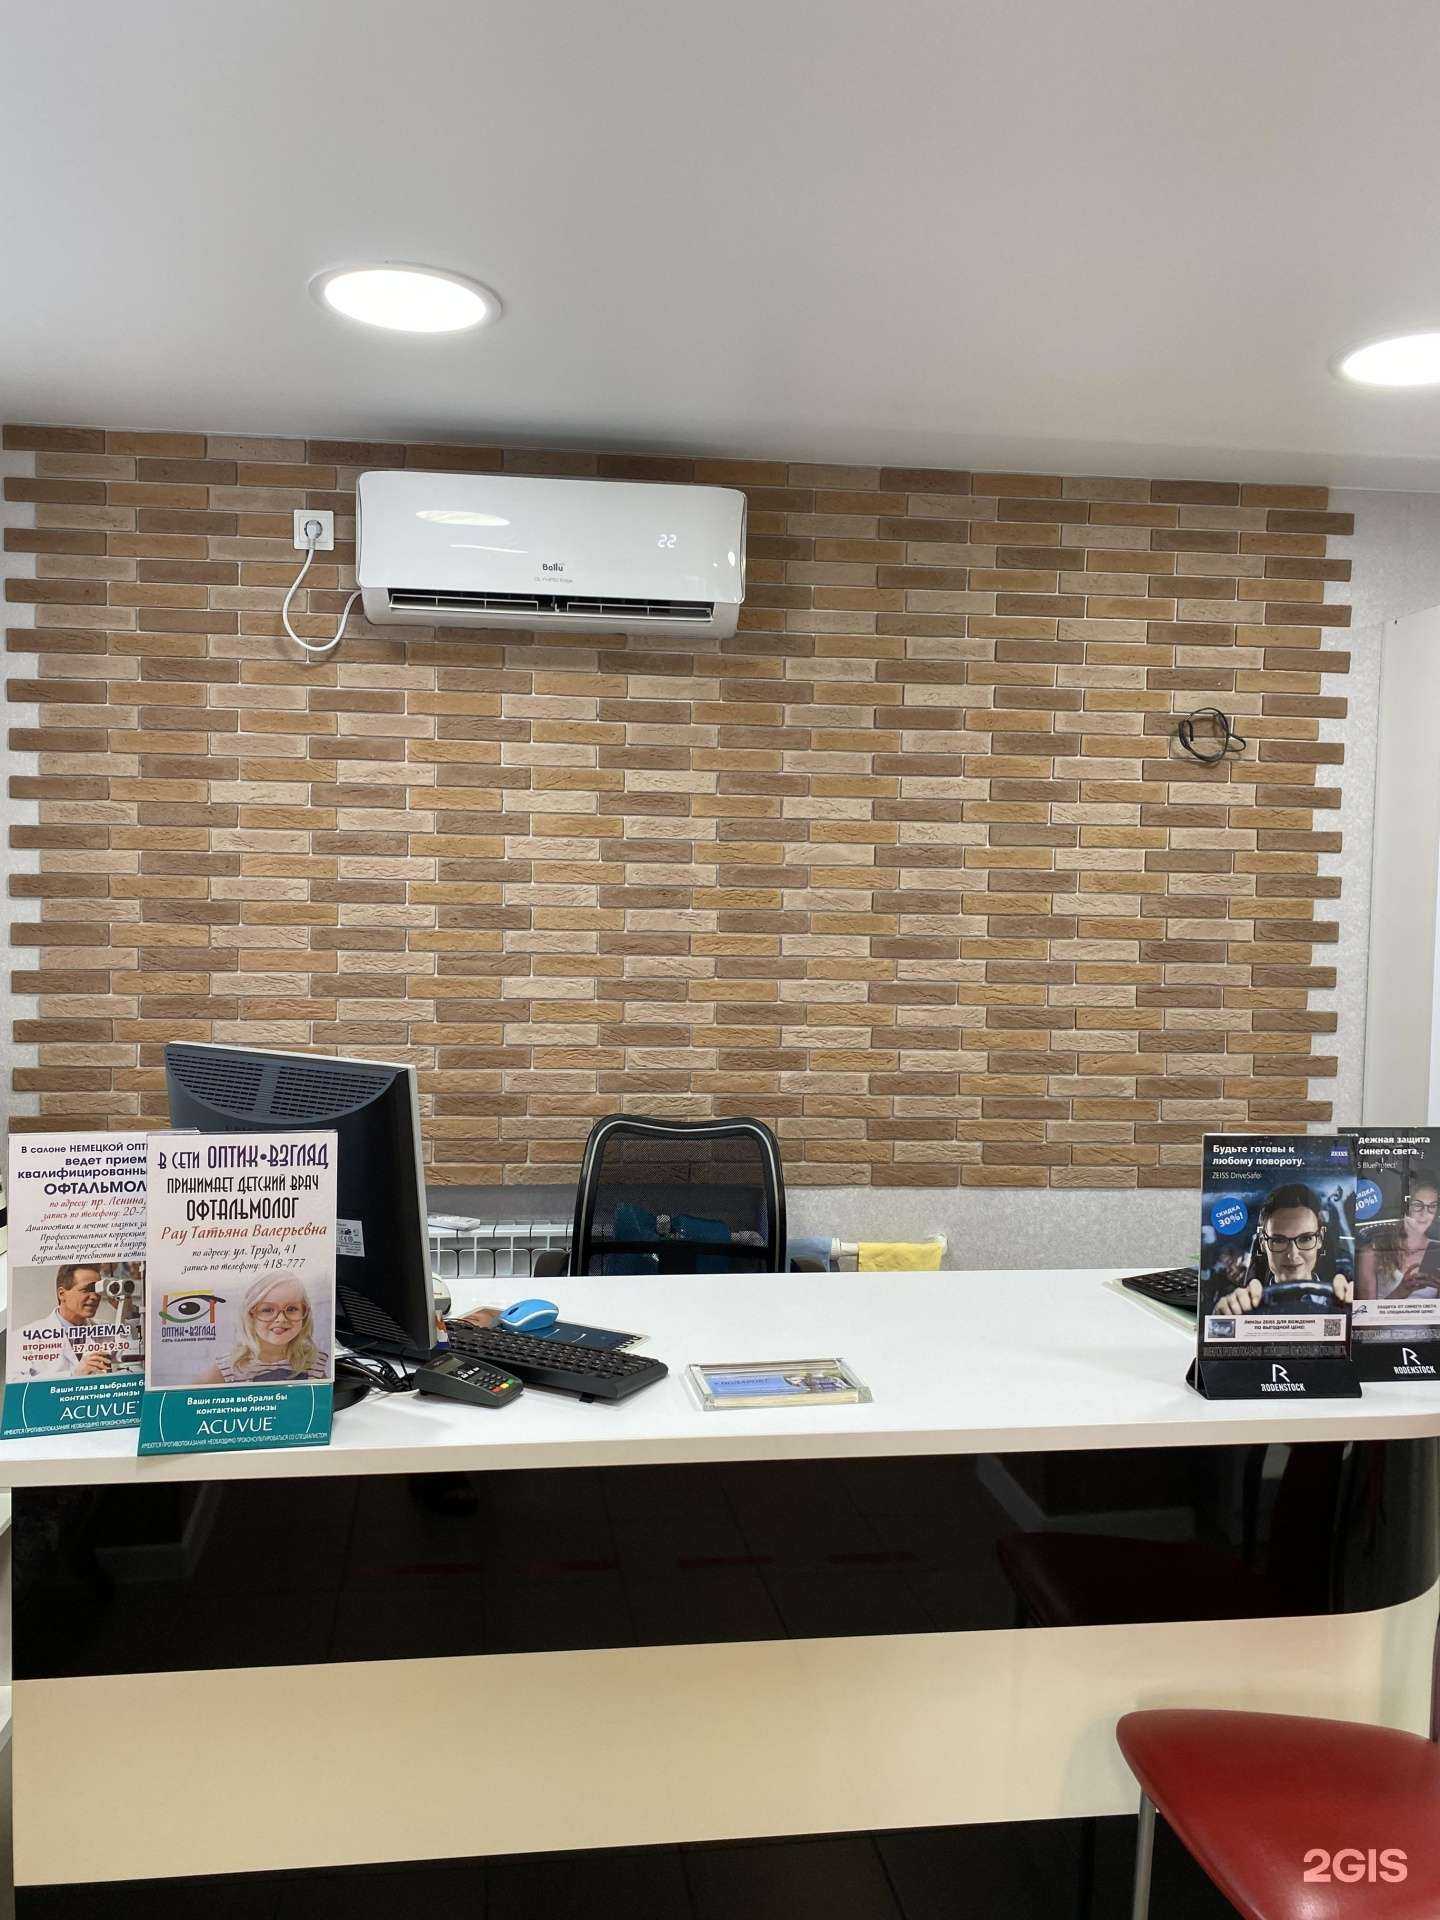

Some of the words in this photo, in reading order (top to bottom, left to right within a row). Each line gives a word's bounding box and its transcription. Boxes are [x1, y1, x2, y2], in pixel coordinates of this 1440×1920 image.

[657, 534, 678, 549] 22
[542, 563, 564, 572] Ballu
[70, 1142, 123, 1152] НЕМЕЦКОЙ
[127, 1143, 148, 1151] ОПТ
[1213, 1144, 1247, 1155] Будьте
[65, 1157, 101, 1166] ведет
[106, 1156, 146, 1167] прием
[157, 1152, 167, 1169] В
[172, 1151, 200, 1169] СЕТИ
[1212, 1157, 1253, 1166] любому
[1256, 1158, 1305, 1167] повороту.
[44, 1181, 146, 1195] ОФТАЛЬМОЛ
[167, 1176, 234, 1194] ПРИНИМАЕТ
[237, 1173, 286, 1194] ДЕТСКИЙ
[290, 1175, 319, 1191] ВРАЧ
[91, 1199, 105, 1210] пр.
[186, 1197, 299, 1221] ОФТАЛЬМОЛОГ
[1216, 1205, 1240, 1218] СКИДКА
[1218, 1212, 1244, 1227] 30%!
[161, 1227, 188, 1245] Рау
[192, 1225, 248, 1239] Татьяна
[252, 1222, 327, 1241] Валерьевна
[203, 1249, 230, 1260] адресу:
[233, 1247, 247, 1260] ул.
[251, 1244, 281, 1258] Труда,
[284, 1244, 296, 1253] 41
[181, 1263, 208, 1275] запись
[221, 1261, 260, 1272] телефону:
[263, 1258, 305, 1268] 418-777
[23, 1329, 63, 1340] ЧАСЫ
[68, 1325, 131, 1338] ПРИЕМА:
[22, 1342, 62, 1351] вторник
[22, 1353, 60, 1362] четверг
[1393, 1364, 1436, 1375] RODENSTOCK
[50, 1386, 73, 1394] Ваши
[76, 1384, 97, 1392] глаза
[99, 1381, 136, 1390] выбрали
[1260, 1382, 1305, 1392] RODENSTOCK
[60, 1392, 111, 1402] контактные
[113, 1390, 140, 1398] линзы
[187, 1397, 211, 1405] Ваши
[212, 1396, 235, 1404] глаза
[237, 1395, 274, 1403] выбрали
[60, 1401, 136, 1420] ACUVUE
[197, 1406, 247, 1415] контактные
[197, 1417, 273, 1435] ACUVUE
